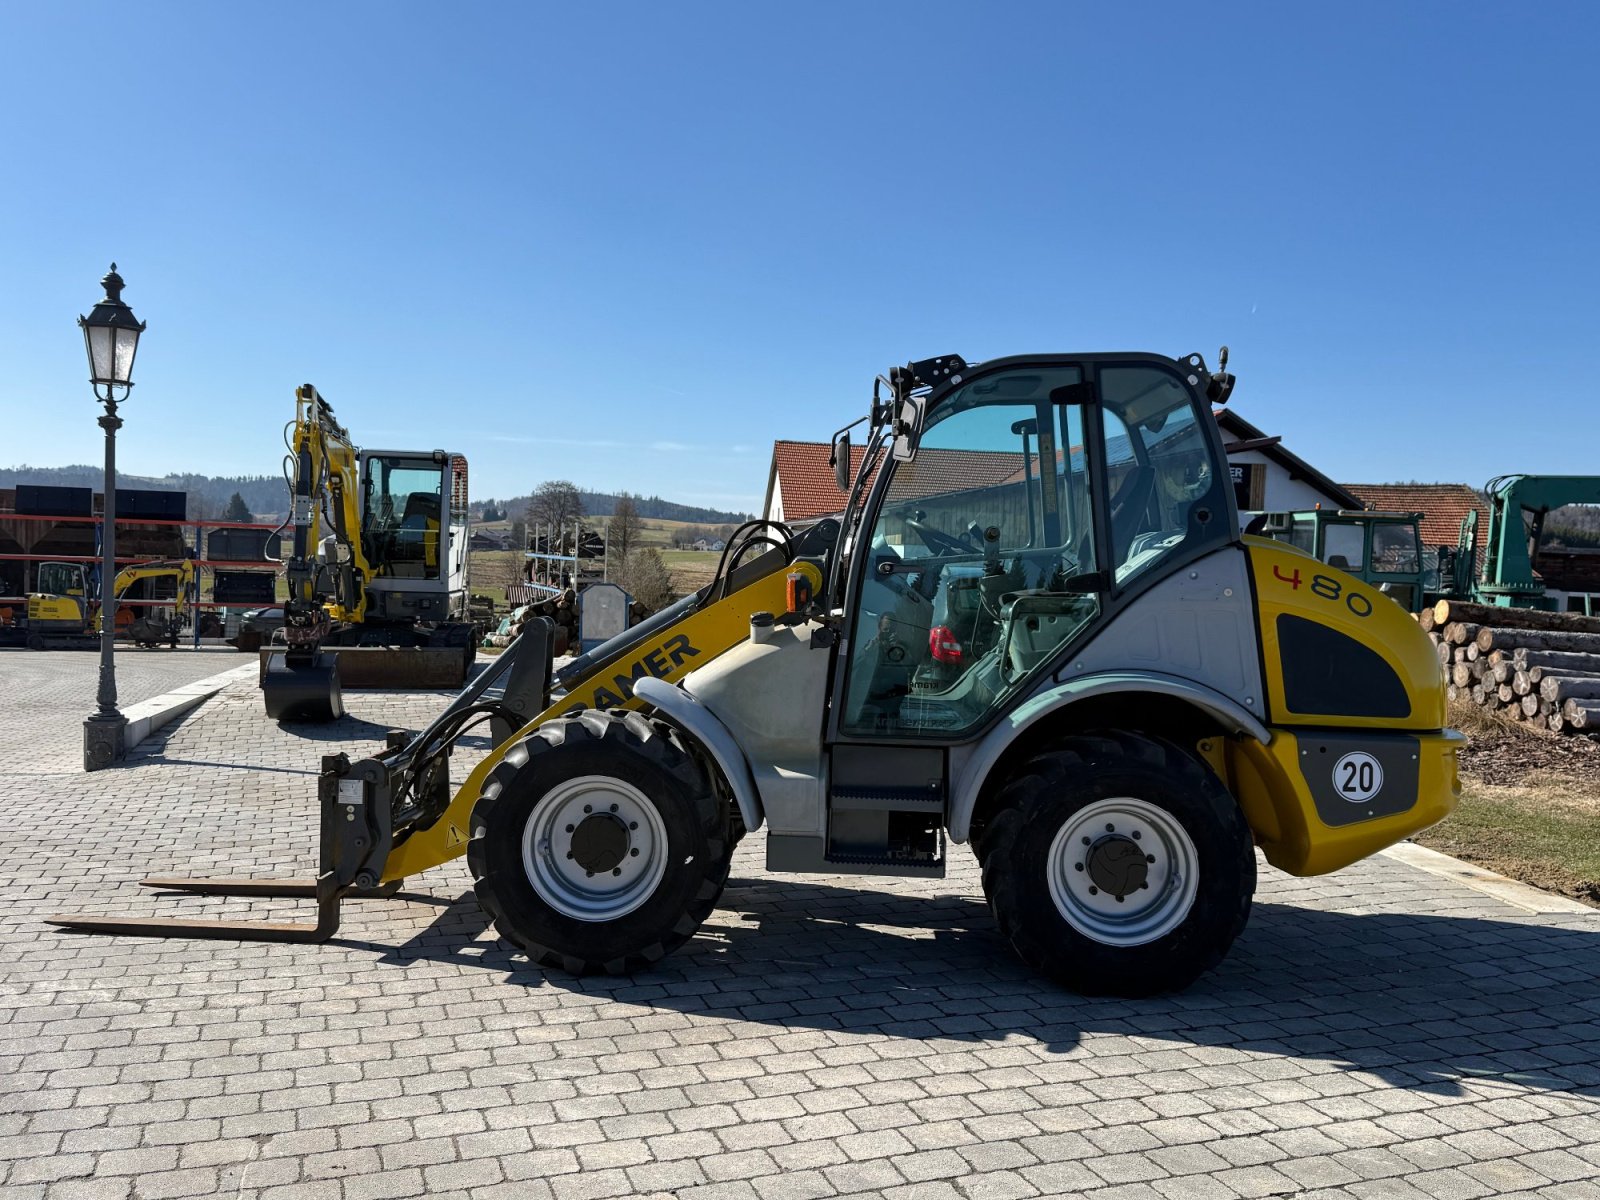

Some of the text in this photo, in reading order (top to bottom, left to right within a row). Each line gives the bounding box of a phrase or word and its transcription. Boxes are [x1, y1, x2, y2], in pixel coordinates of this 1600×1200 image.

[1273, 565, 1373, 617] 480
[565, 634, 702, 712] AMER
[1342, 761, 1374, 793] 20
